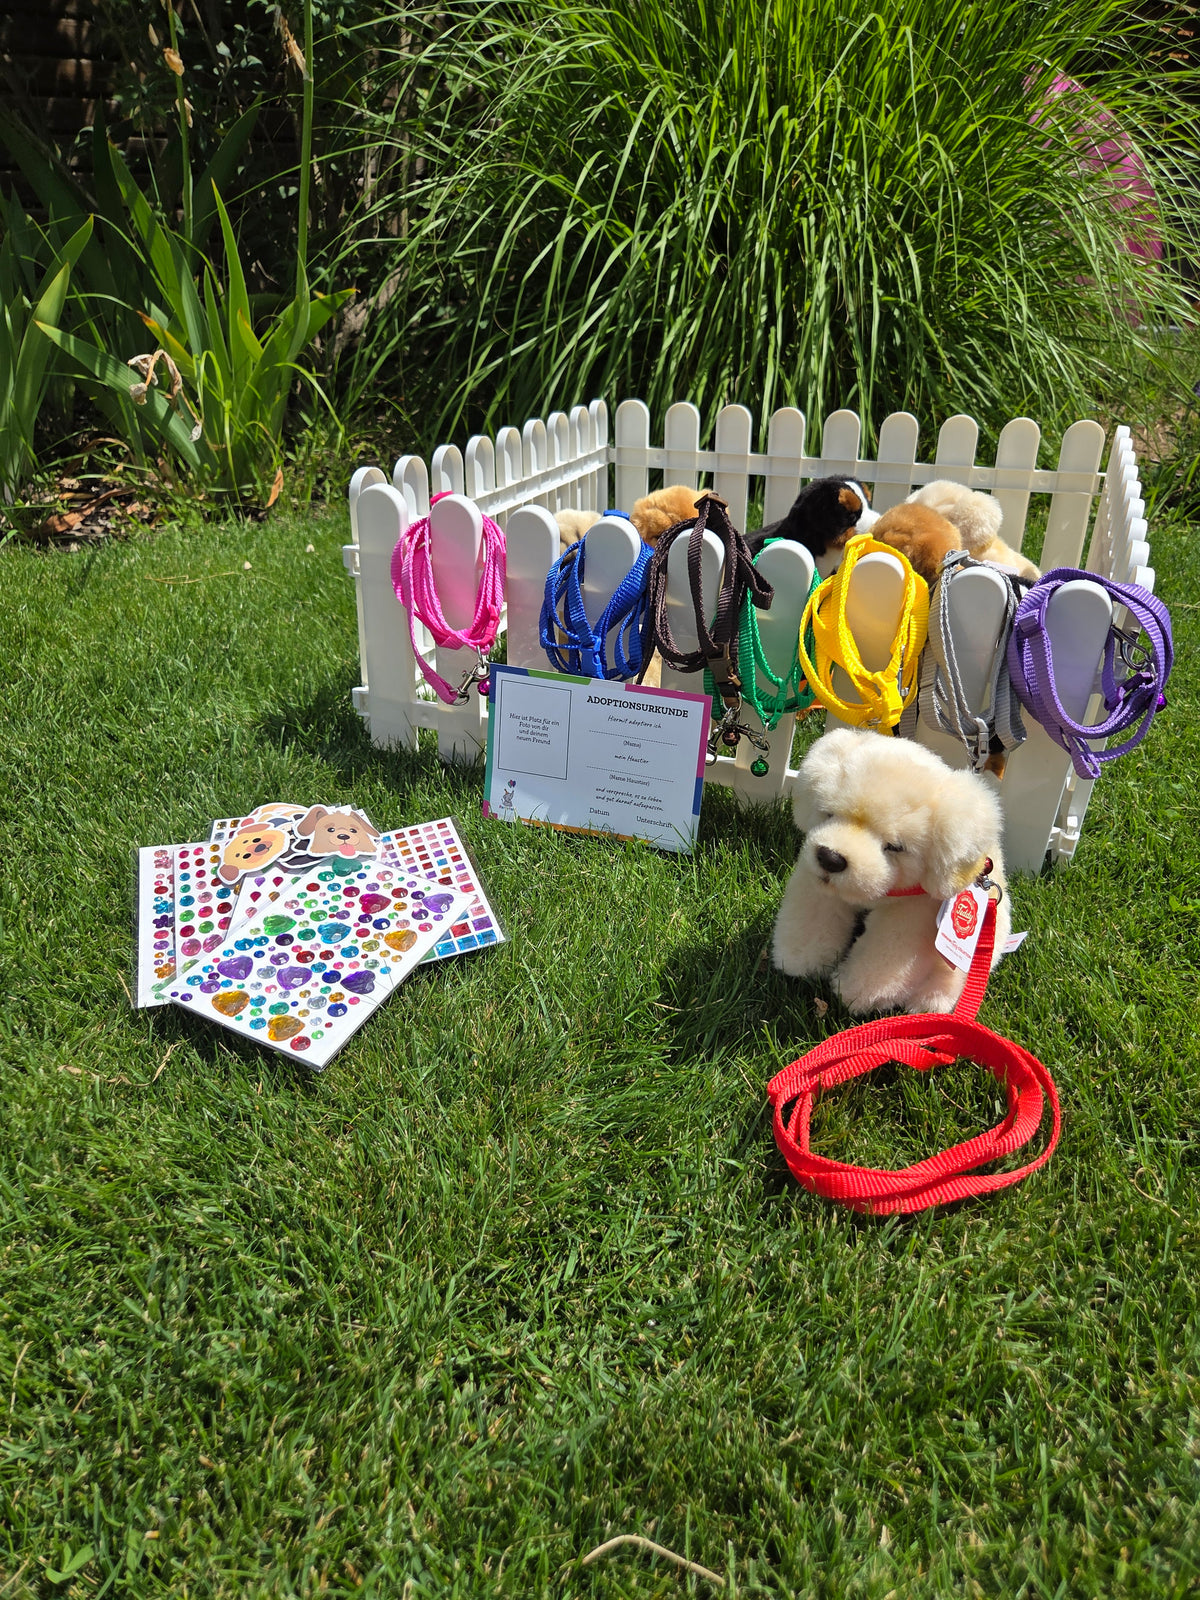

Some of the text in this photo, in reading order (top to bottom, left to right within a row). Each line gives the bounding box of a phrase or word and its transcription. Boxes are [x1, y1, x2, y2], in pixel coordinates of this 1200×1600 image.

[586, 695, 689, 718] ADOPTIONSURKUNDE
[607, 714, 628, 724] Hiermit
[628, 719, 653, 728] adoptiere
[622, 740, 642, 749] (Name)
[626, 755, 649, 764] Haustier
[626, 777, 650, 787] Haustier)
[615, 797, 633, 806] darauf
[589, 807, 610, 817] Datum
[636, 816, 672, 828] Unterschrift
